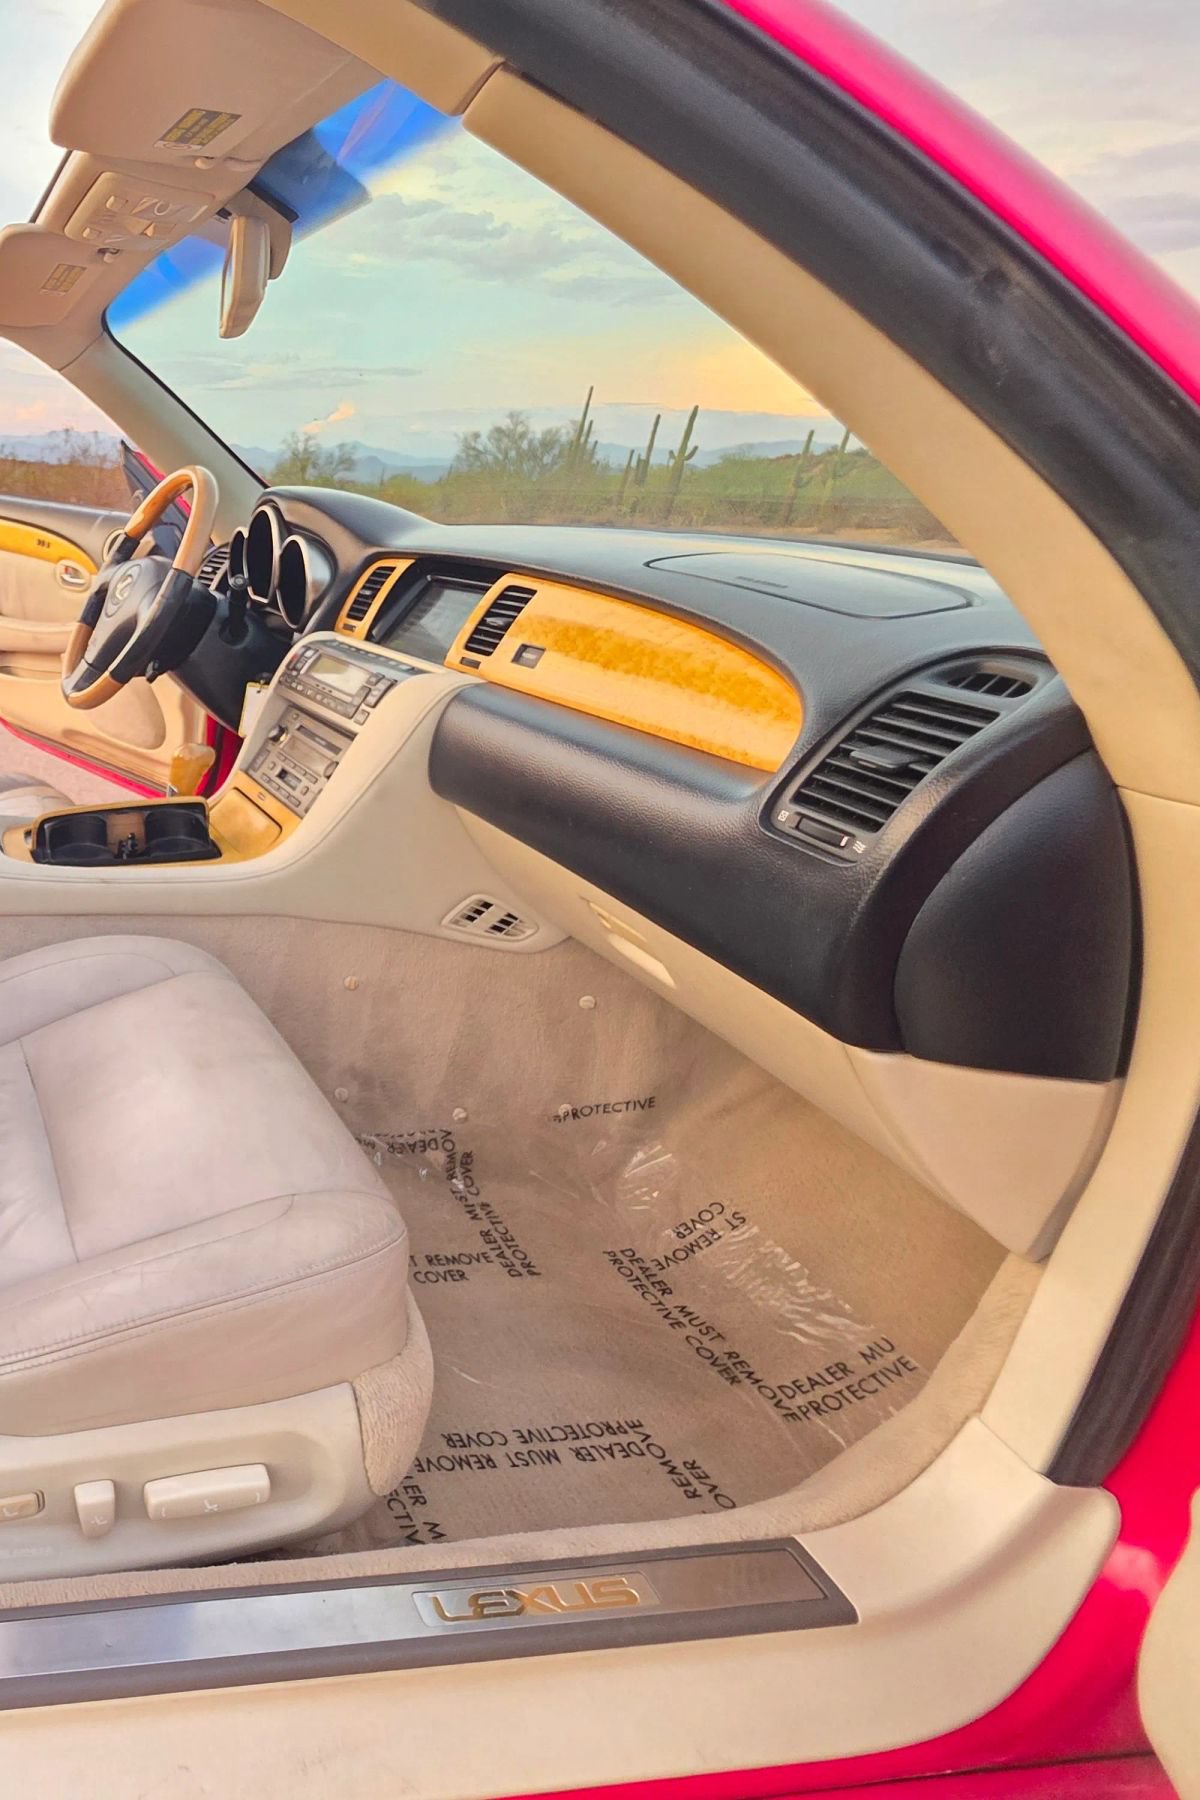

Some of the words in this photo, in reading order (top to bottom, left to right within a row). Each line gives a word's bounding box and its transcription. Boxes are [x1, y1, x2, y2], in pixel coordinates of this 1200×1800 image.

[562, 1096, 656, 1122] PROTECTIVE
[460, 1150, 481, 1197] COVER
[673, 1201, 725, 1240] COVER
[425, 1253, 494, 1268] REMOVE
[480, 1228, 523, 1278] DEALER
[651, 1228, 722, 1272] REMOVE
[413, 1269, 470, 1285] COVER
[602, 1250, 687, 1330] PROTECTIVE
[685, 1334, 743, 1387] COVER
[620, 1248, 673, 1297] DEALER
[674, 1304, 726, 1342] MUST
[724, 1350, 803, 1424] REMOVE
[777, 1361, 855, 1399] DEALER
[797, 1355, 920, 1421] PROTECTIVE
[440, 1430, 508, 1449] COVER
[512, 1421, 632, 1445] PROTECTIVE
[568, 1440, 646, 1462] DEALER
[414, 1453, 498, 1473] REMOVE
[504, 1448, 562, 1469] MUST
[682, 1459, 737, 1510] OVER
[431, 1577, 641, 1622] LEXUS
